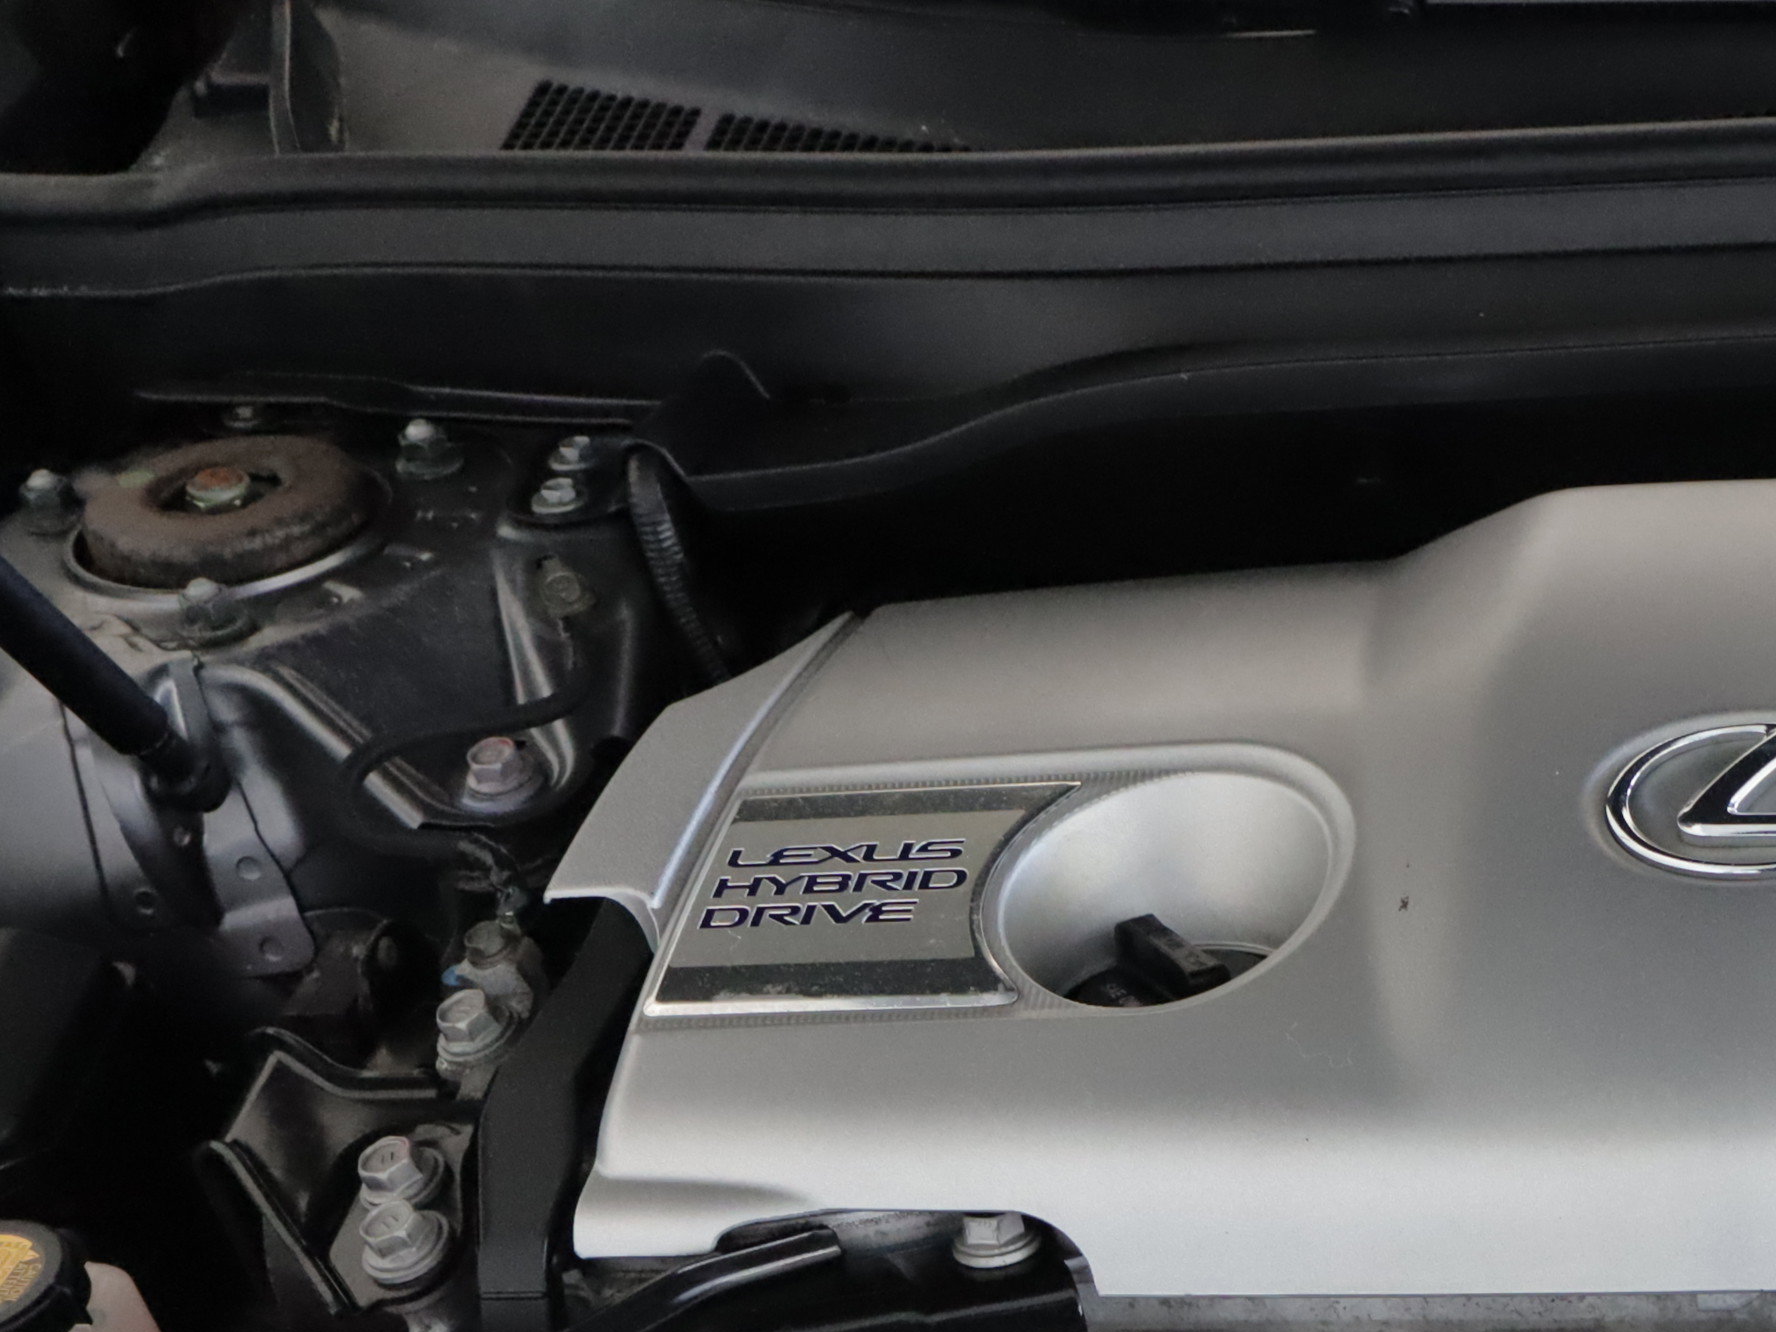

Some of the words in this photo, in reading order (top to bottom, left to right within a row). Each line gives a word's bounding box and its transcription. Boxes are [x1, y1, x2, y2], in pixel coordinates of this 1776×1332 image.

[727, 838, 966, 868] LEXUS
[712, 868, 969, 898] HYBRID
[697, 899, 919, 929] DRIVE
